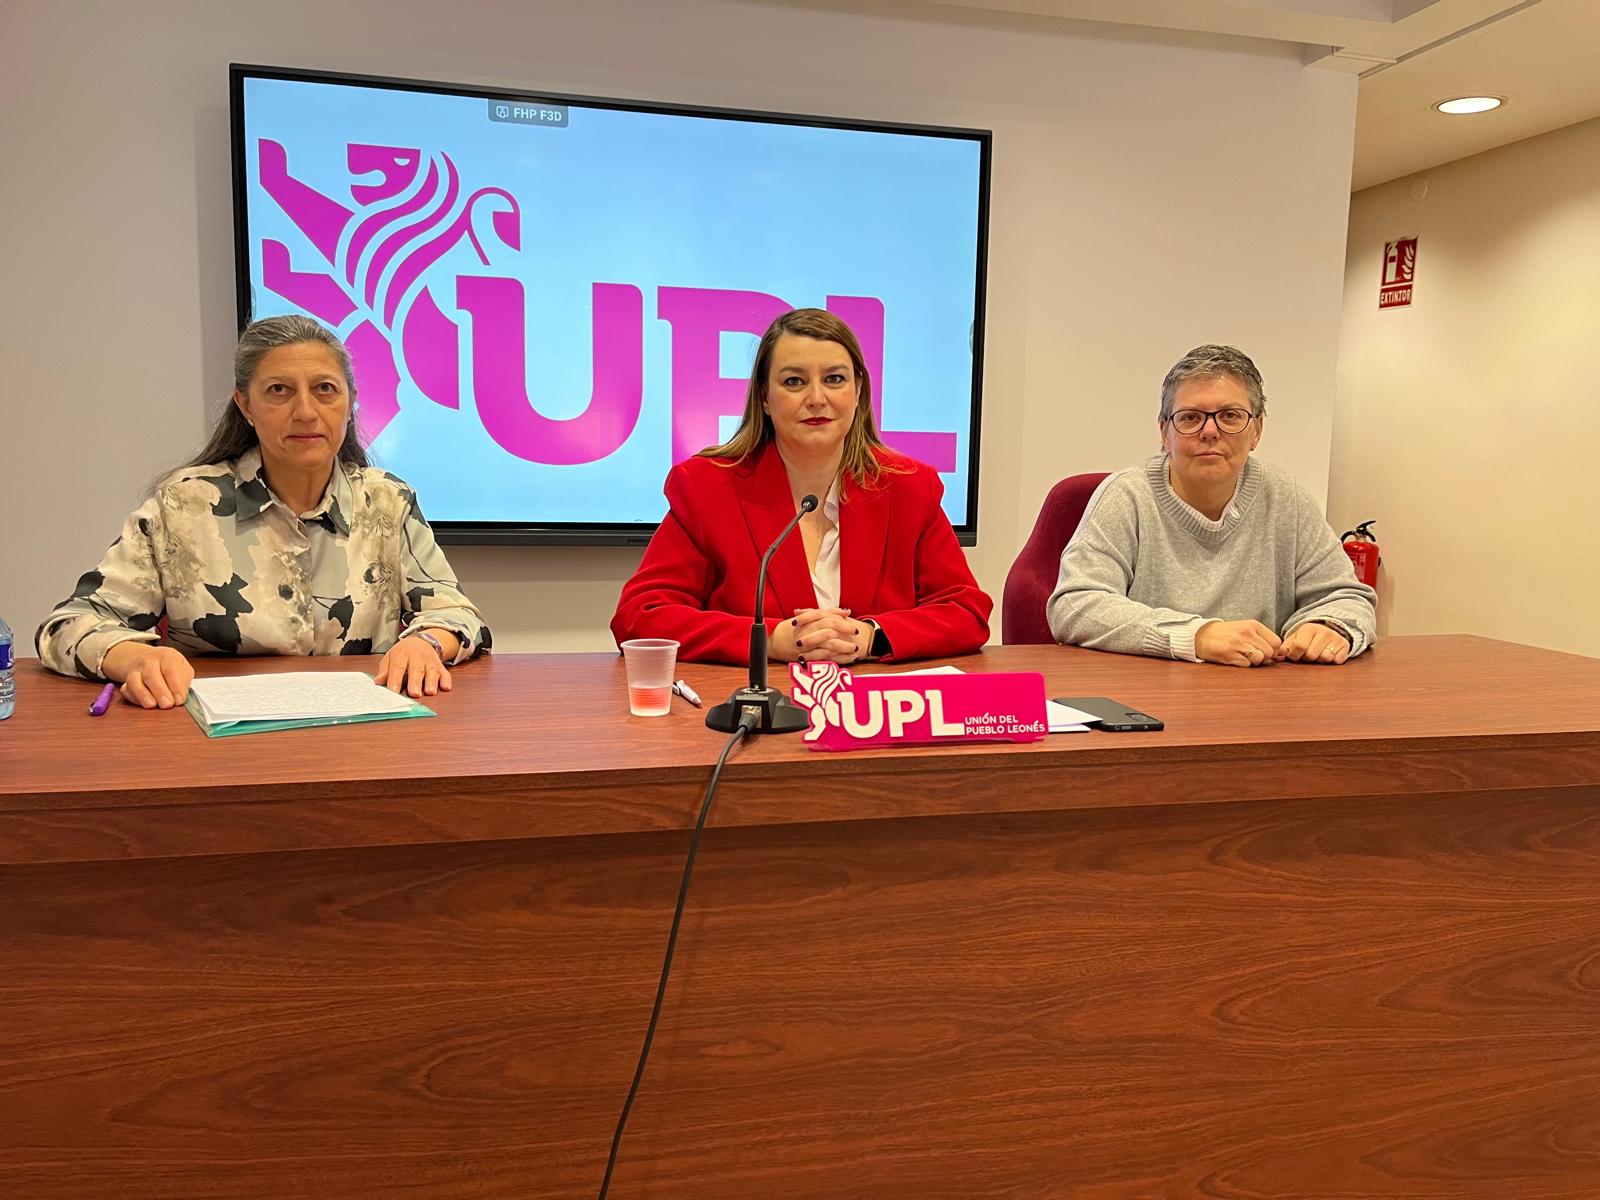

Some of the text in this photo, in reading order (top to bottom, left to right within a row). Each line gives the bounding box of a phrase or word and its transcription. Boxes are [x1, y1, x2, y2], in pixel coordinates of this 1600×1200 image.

[513, 107, 562, 121] FHP F3D
[1381, 289, 1411, 305] EXTINTOR
[836, 689, 965, 739] UPL
[965, 712, 1019, 725] UNIÓN DEL
[966, 720, 1045, 735] PUEBLO LEONÉS
